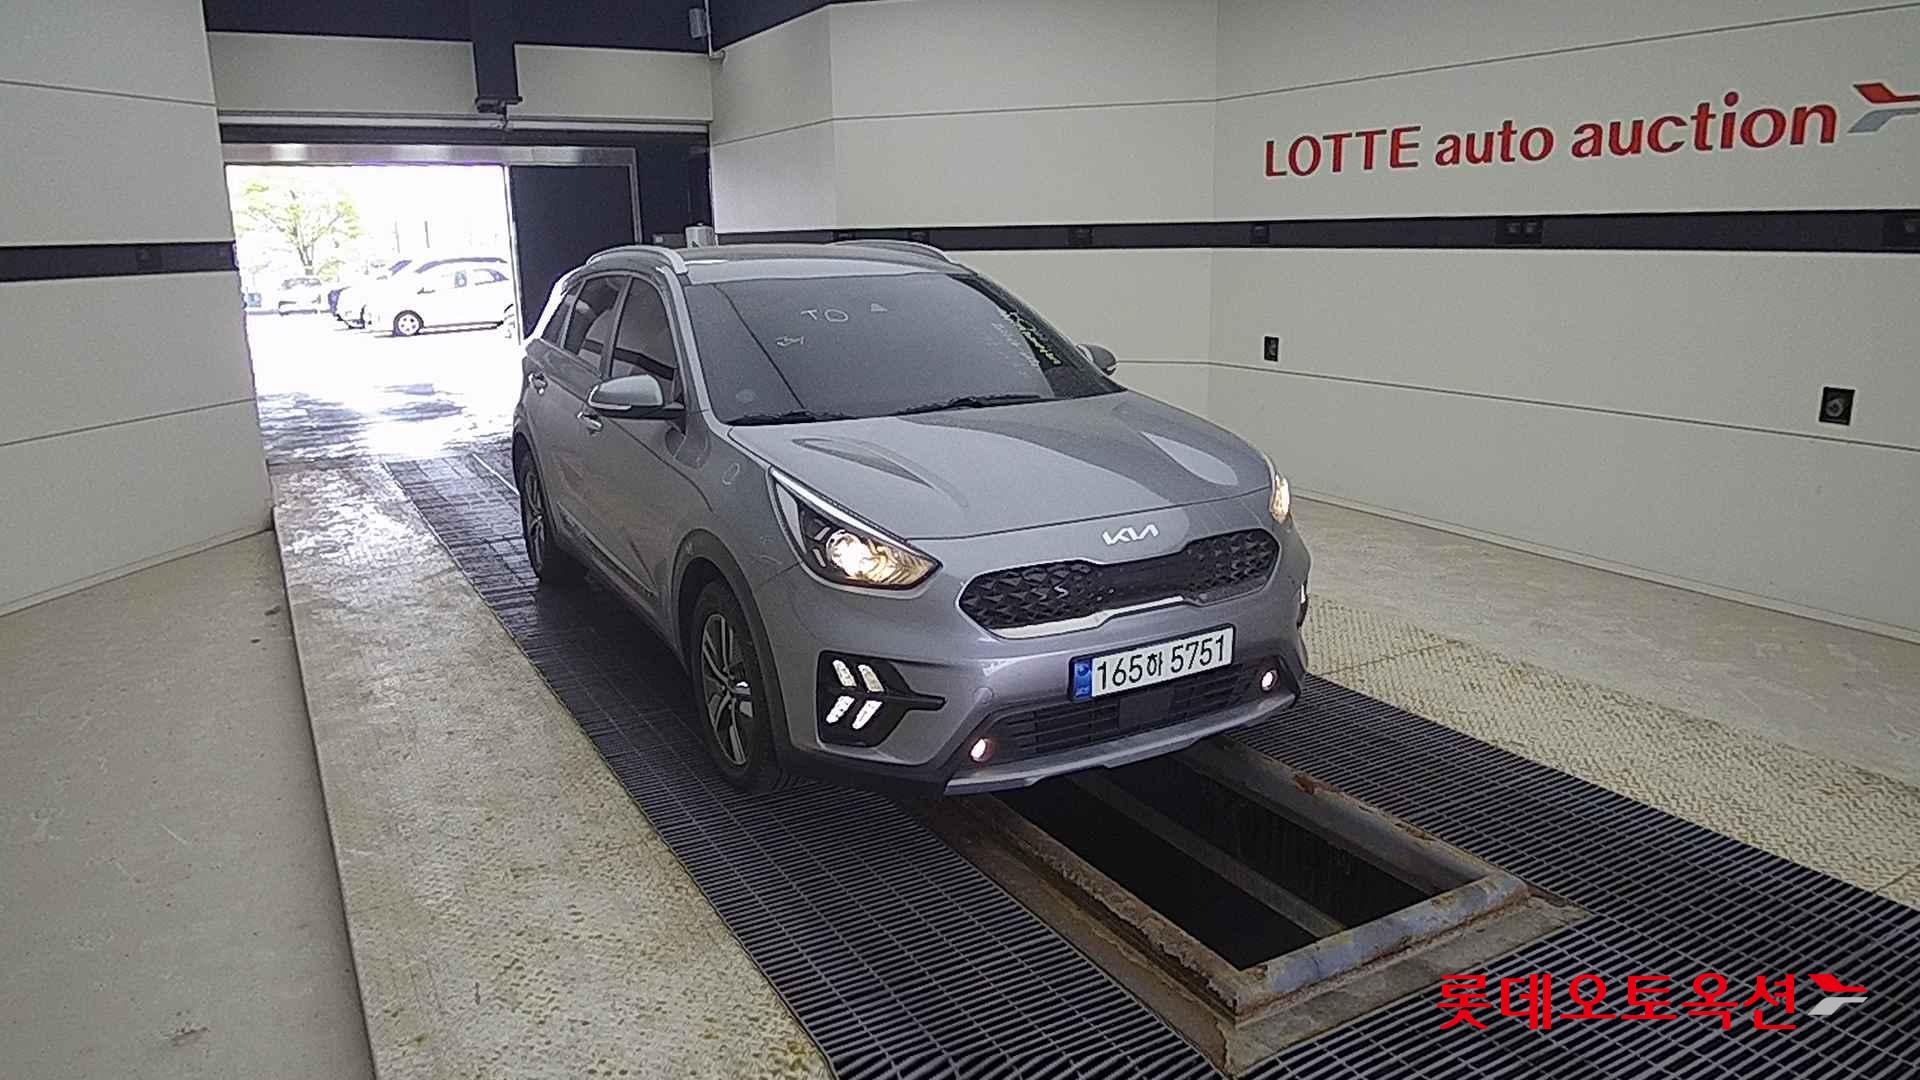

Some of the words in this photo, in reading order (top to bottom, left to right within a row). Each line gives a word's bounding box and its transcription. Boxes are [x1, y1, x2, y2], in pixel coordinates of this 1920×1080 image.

[1265, 124, 1421, 177] LOTTE
[1435, 120, 1554, 166] auto
[1571, 91, 1838, 158] auction
[1170, 635, 1225, 674] 5751
